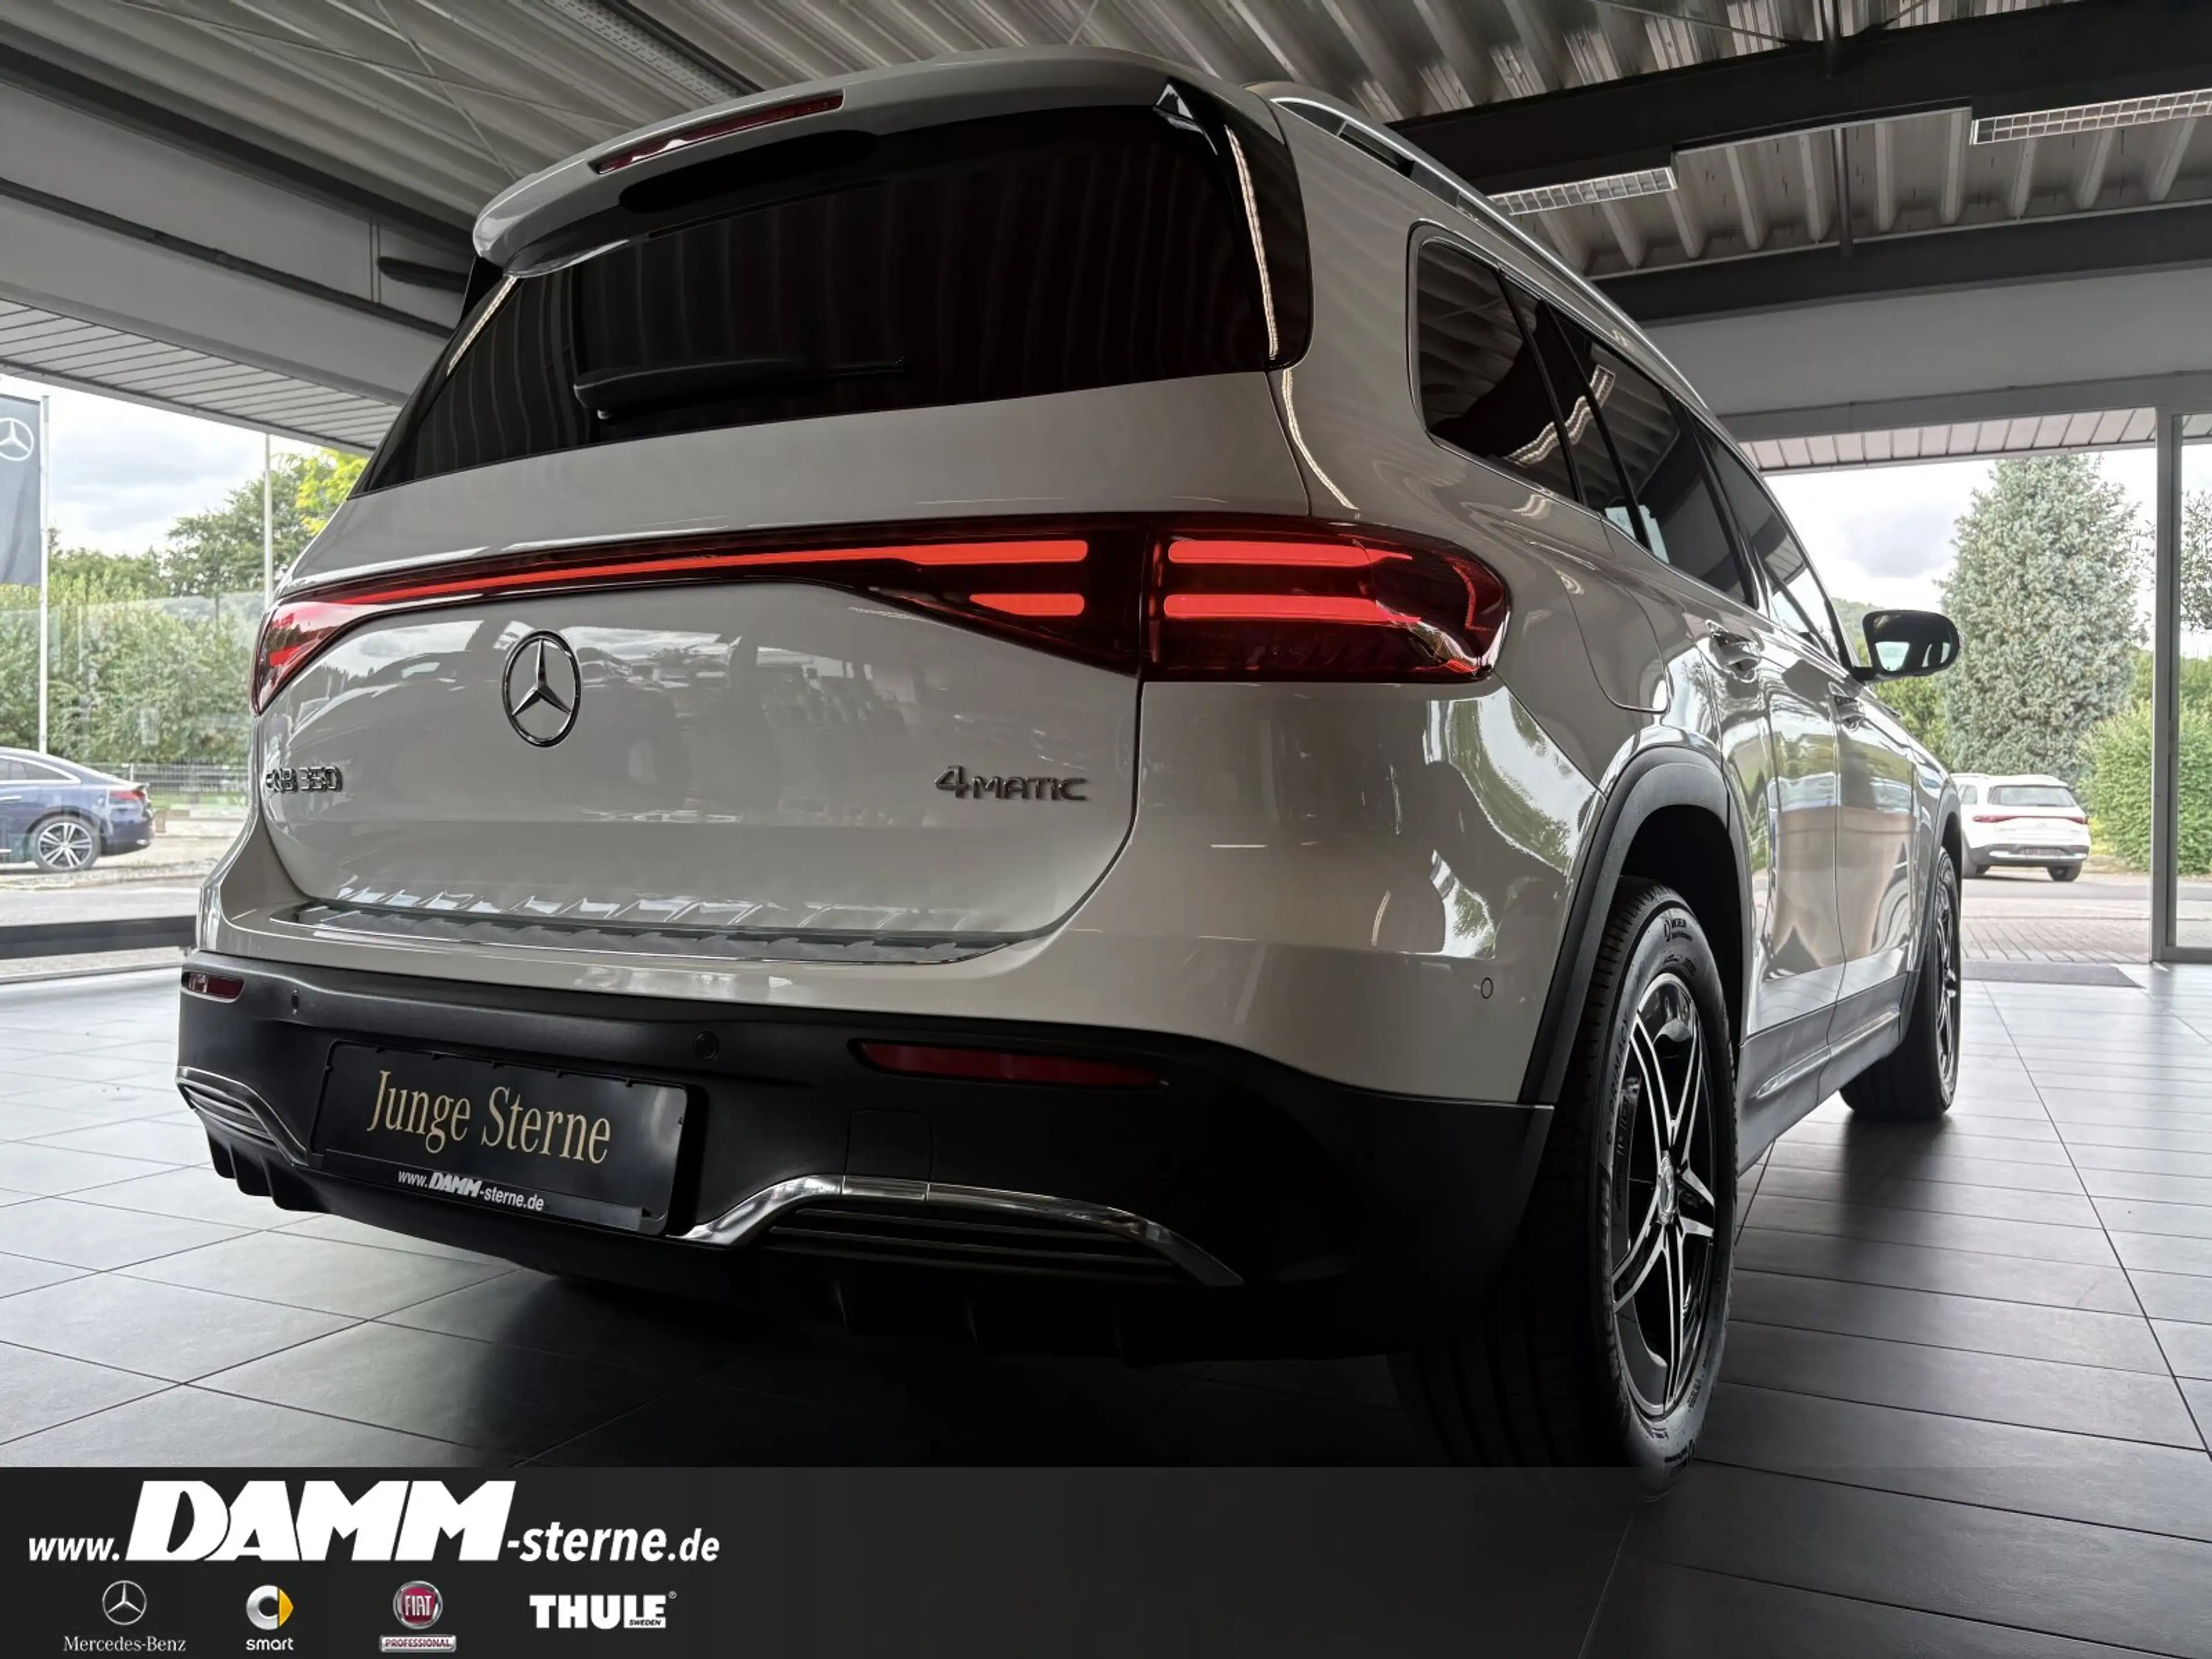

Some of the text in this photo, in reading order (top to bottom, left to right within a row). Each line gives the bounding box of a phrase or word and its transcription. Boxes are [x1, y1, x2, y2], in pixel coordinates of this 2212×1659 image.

[298, 766, 343, 792] 350
[934, 764, 1088, 801] 4MATIC
[366, 1070, 612, 1164] Junge Sterne
[397, 1171, 544, 1211] www.DAMM-sterne.de
